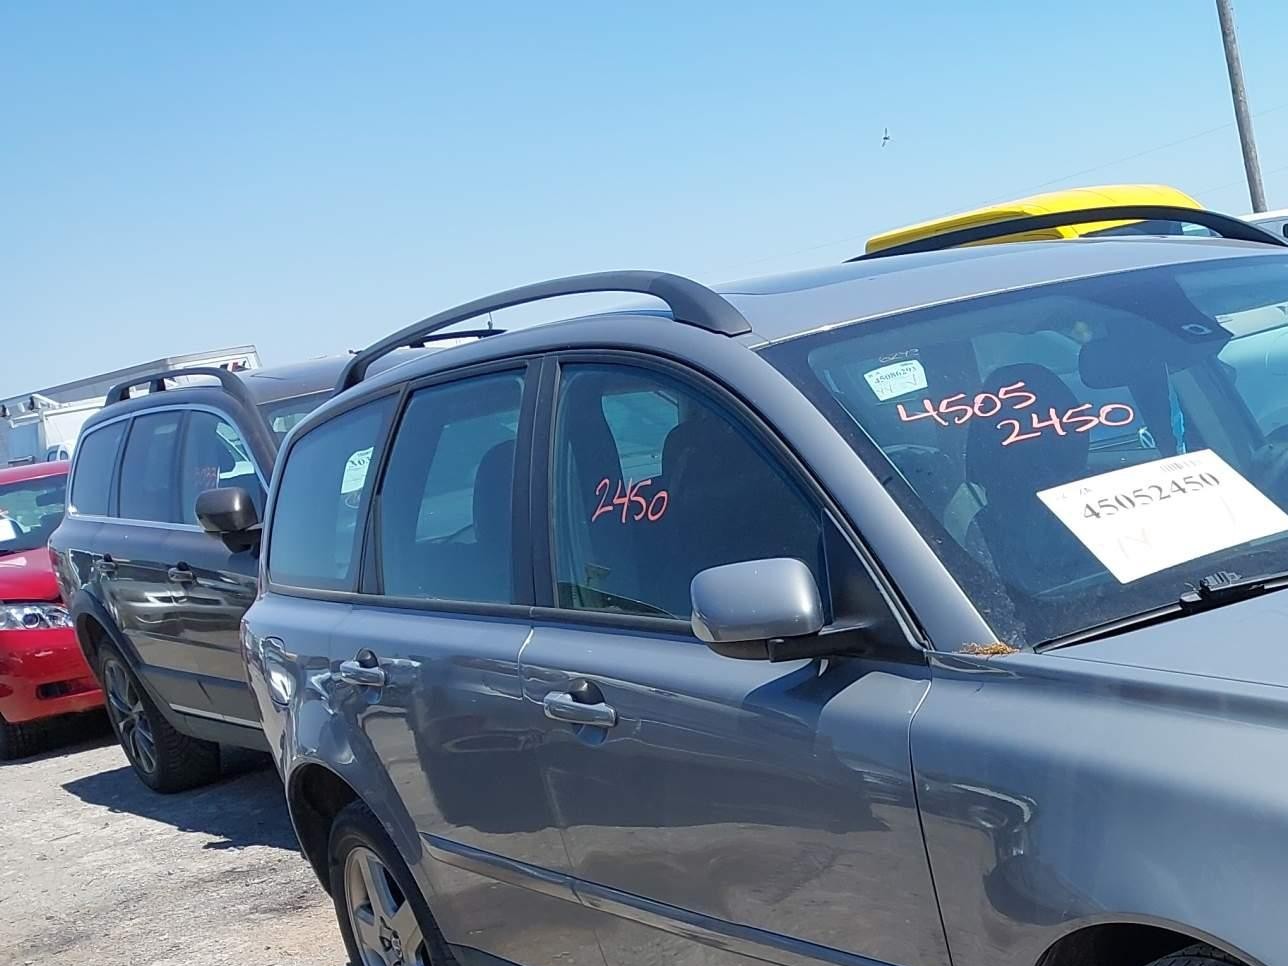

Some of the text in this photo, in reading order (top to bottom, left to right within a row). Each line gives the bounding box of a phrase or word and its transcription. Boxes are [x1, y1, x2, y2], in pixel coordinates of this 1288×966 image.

[896, 381, 1036, 426] 4505
[996, 403, 1134, 446] 2450
[591, 477, 668, 523] 2450
[1083, 472, 1220, 520] 45052450
